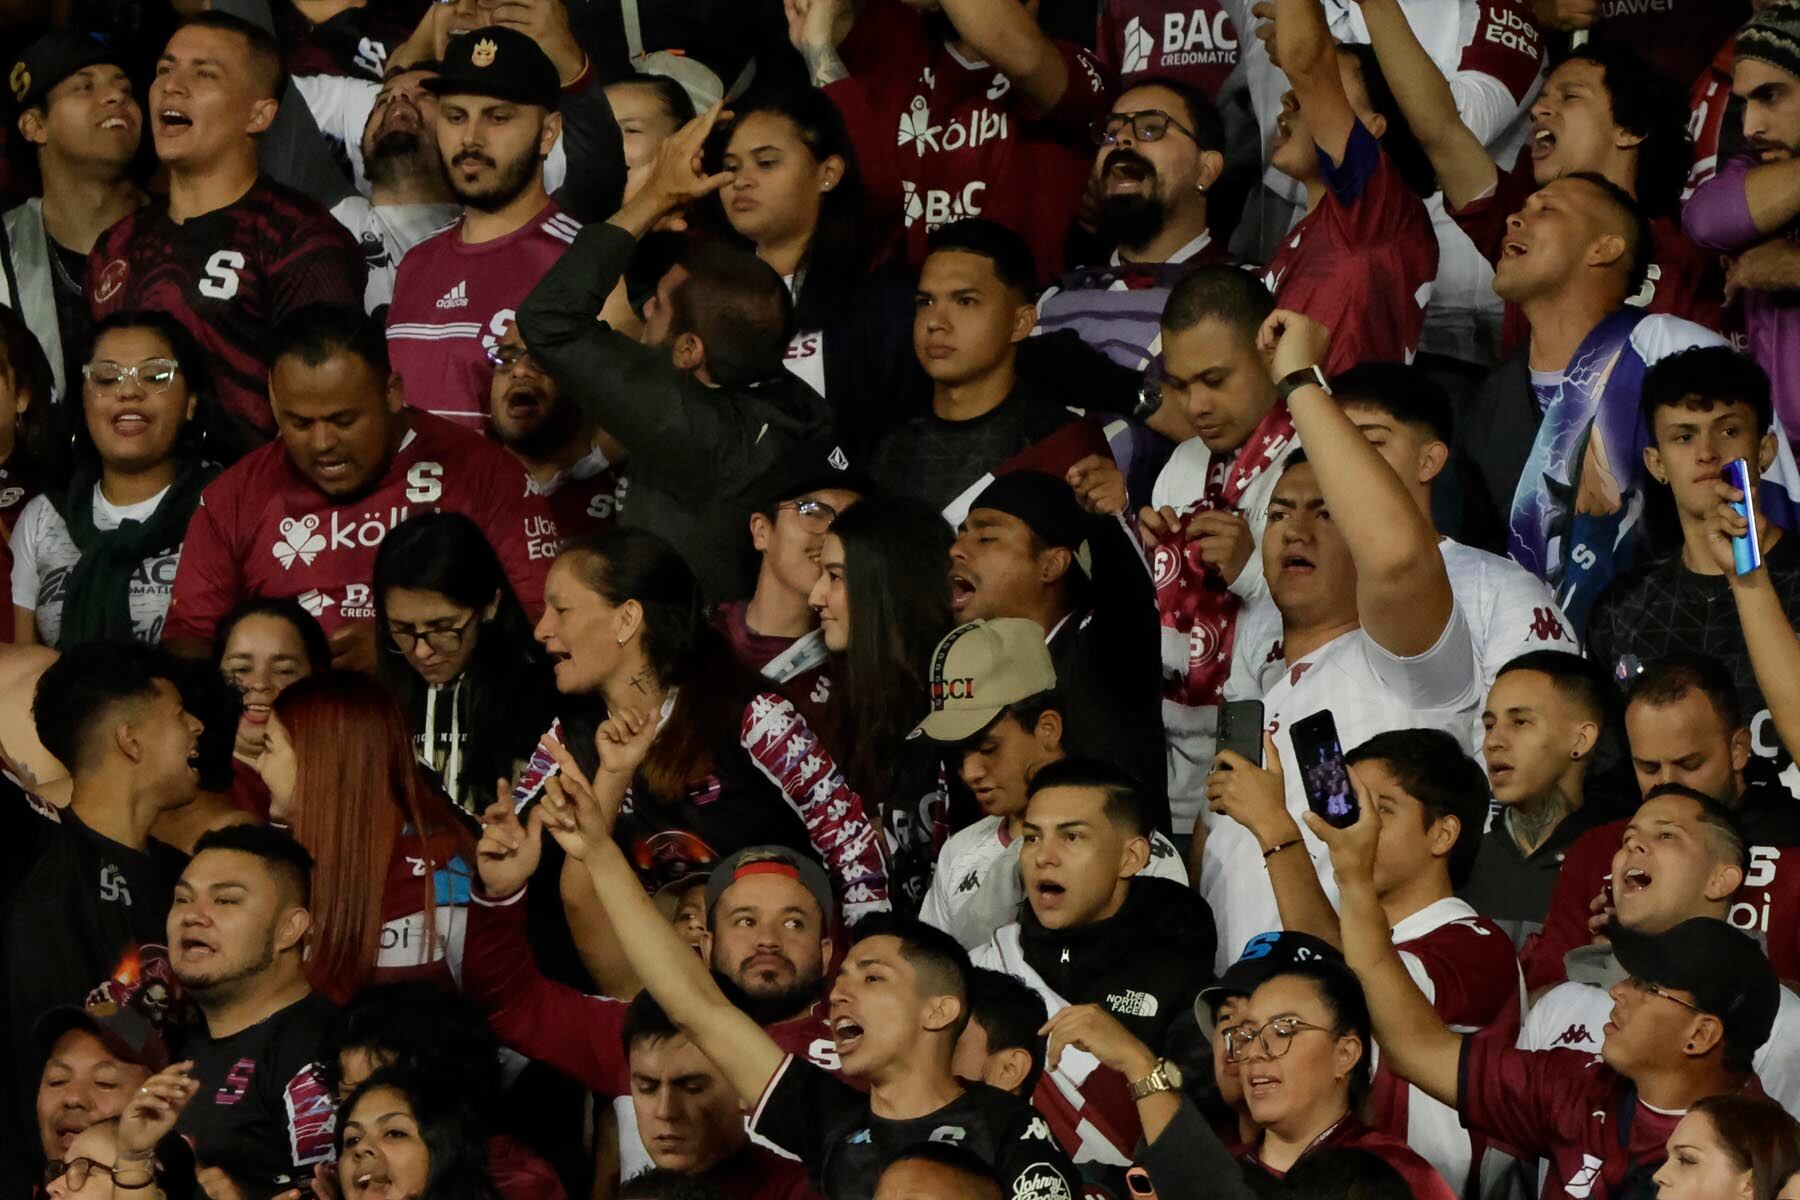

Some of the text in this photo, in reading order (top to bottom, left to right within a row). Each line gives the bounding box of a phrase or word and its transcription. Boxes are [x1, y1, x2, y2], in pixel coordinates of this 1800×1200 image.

[1162, 7, 1239, 54] BAC
[1485, 22, 1539, 61] Eats
[1488, 6, 1540, 45] Uber
[352, 35, 389, 79] S
[1160, 48, 1239, 68] CREDOMATIC
[197, 248, 247, 303] S
[435, 296, 470, 311] adidas
[405, 460, 444, 504] S
[1571, 542, 1599, 571] S
[1239, 931, 1283, 962] S
[1105, 992, 1145, 1010] NORTH
[1111, 1003, 1142, 1018] FACE
[1124, 988, 1145, 1001] THE
[807, 1037, 844, 1071] S
